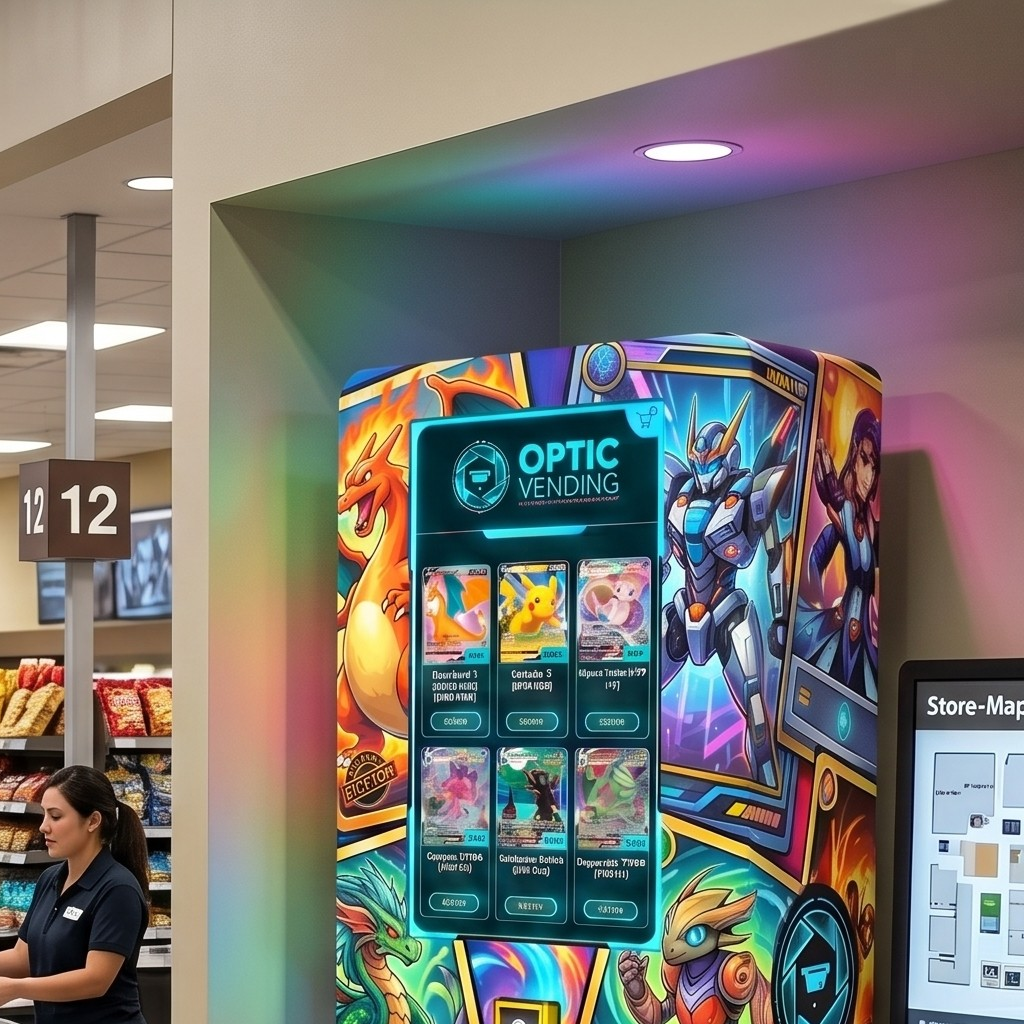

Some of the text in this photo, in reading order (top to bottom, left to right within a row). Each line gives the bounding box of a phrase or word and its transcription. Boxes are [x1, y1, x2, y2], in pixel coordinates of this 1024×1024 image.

[518, 437, 620, 475] OPTIC
[518, 472, 619, 499] VENDING
[23, 486, 44, 535] 12
[61, 484, 118, 535] 12
